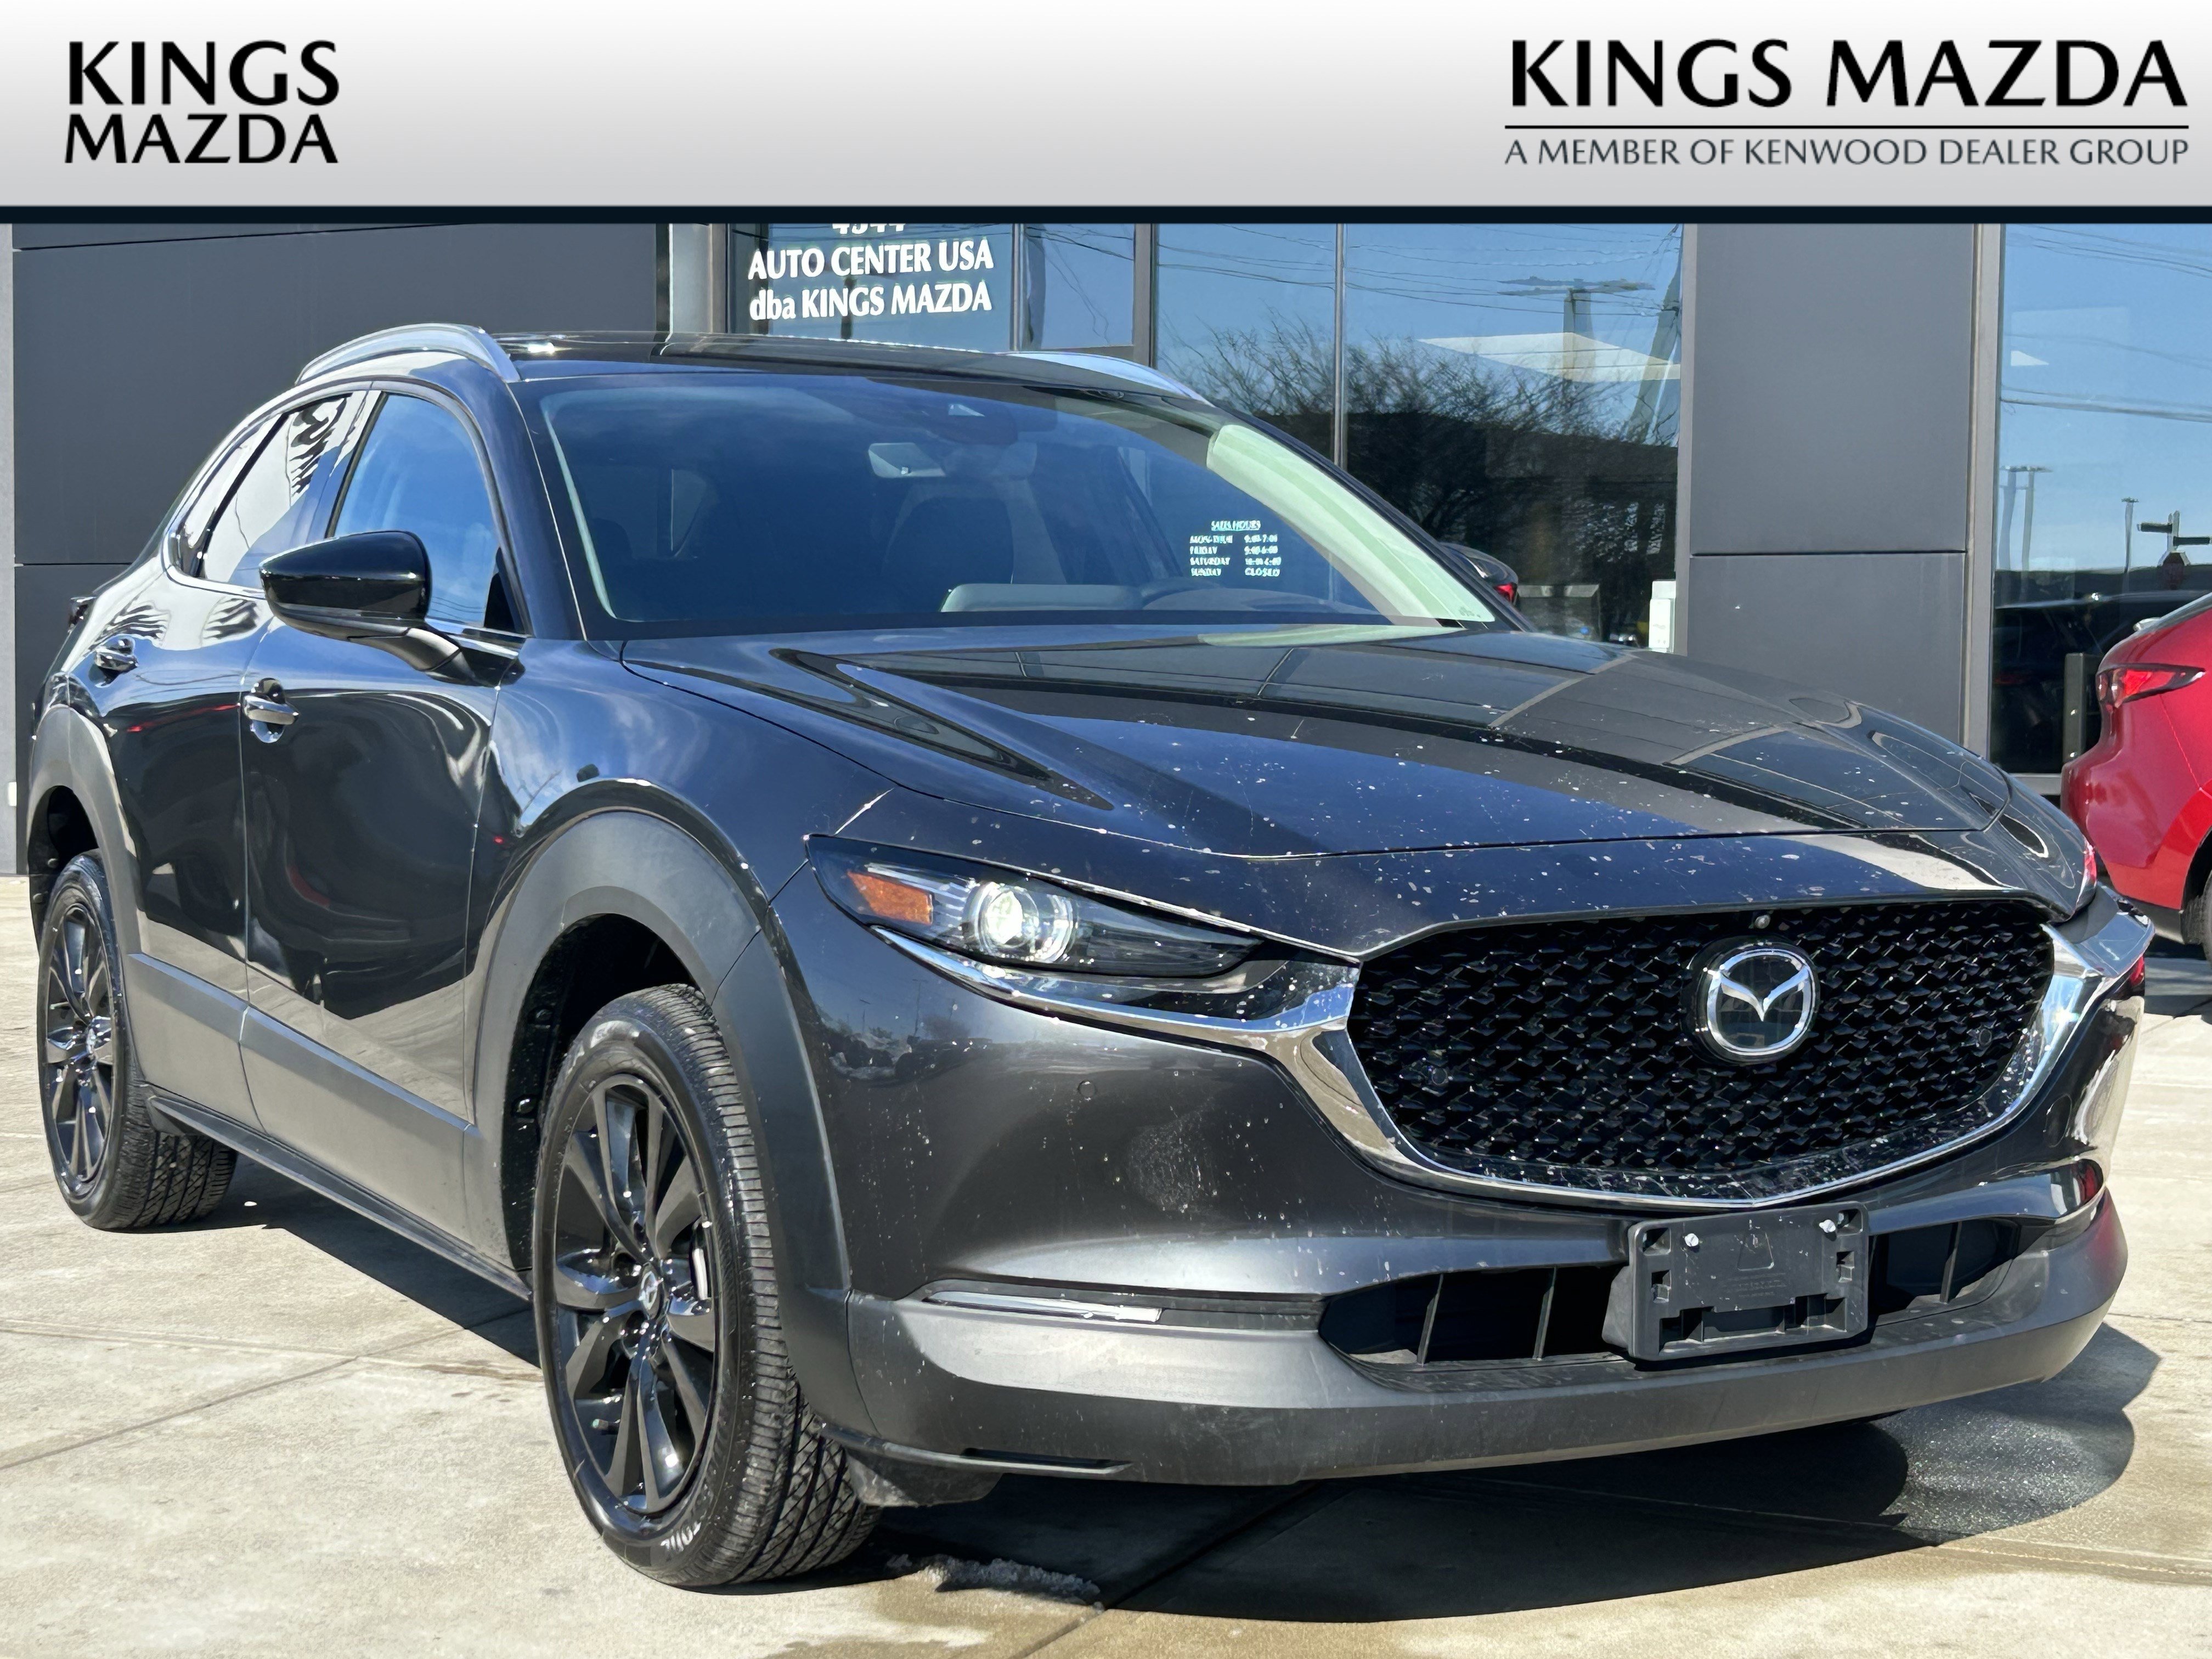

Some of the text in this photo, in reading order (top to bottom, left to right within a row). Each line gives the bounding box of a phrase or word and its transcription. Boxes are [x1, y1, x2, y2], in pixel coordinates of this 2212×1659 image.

[748, 240, 994, 279] AUTO CENTER USA
[750, 281, 991, 320] dba KINGS MAZDA
